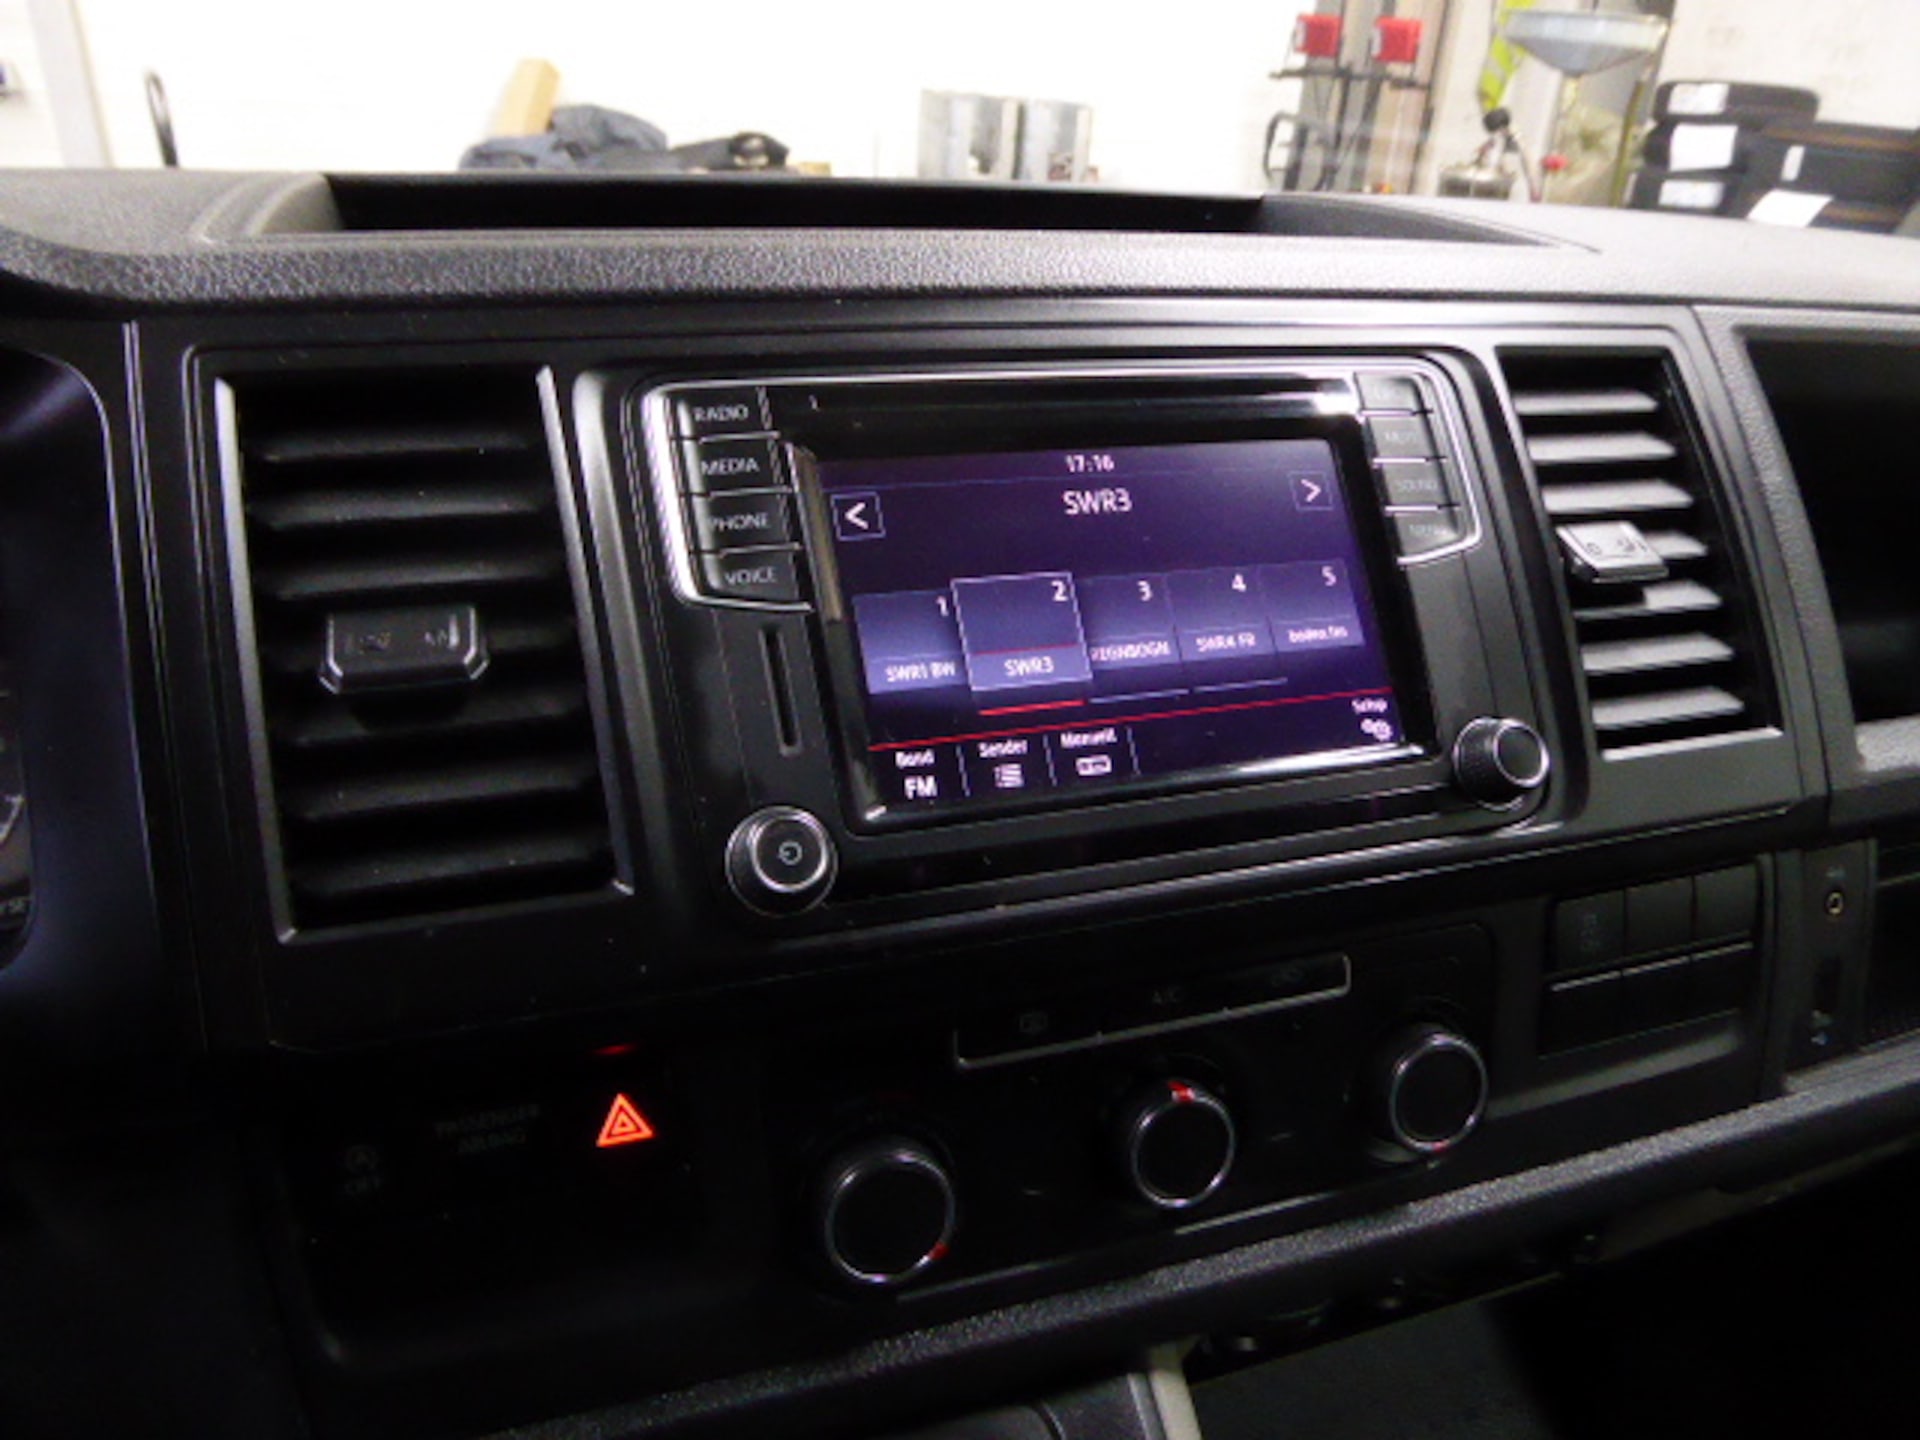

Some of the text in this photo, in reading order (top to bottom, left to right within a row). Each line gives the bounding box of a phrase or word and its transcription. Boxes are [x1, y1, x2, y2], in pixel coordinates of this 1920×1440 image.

[694, 403, 749, 422] RADIO
[701, 456, 760, 476] MEDIA
[1065, 454, 1115, 473] 17:16
[1062, 487, 1133, 515] SWR3
[709, 511, 770, 532] PHONE
[724, 565, 776, 588] VOICE
[1231, 573, 1247, 593] 4
[1321, 566, 1337, 586] 5
[1050, 580, 1068, 602] 2
[1136, 580, 1153, 601] 3
[935, 596, 949, 617] 1
[885, 662, 929, 682] SWR1
[1003, 656, 1055, 676] SWR3
[979, 739, 1028, 758] Sender
[895, 749, 935, 769] Band
[904, 775, 938, 799] FM
